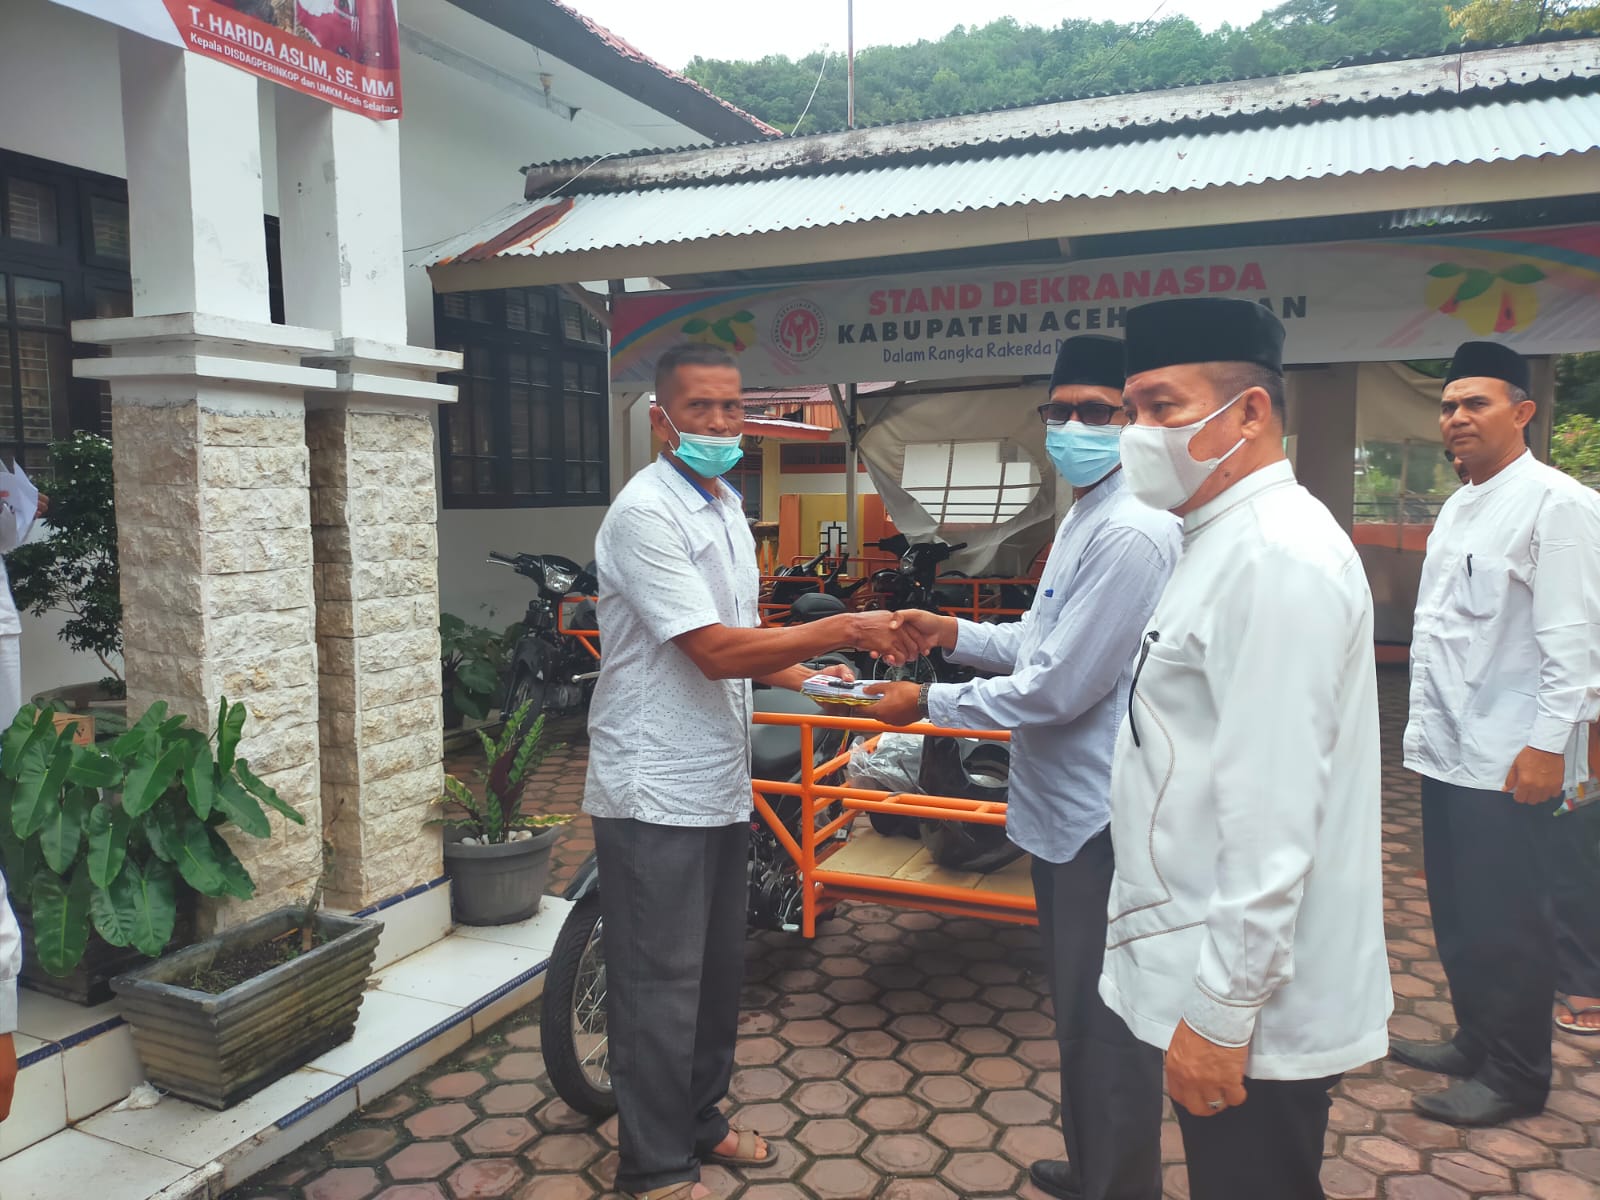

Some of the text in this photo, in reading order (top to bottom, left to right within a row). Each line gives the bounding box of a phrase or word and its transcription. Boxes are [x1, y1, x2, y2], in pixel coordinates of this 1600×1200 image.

[188, 5, 395, 97] T. HARIDA ASLIM, SE. MM
[190, 32, 223, 53] Kepala
[300, 76, 316, 89] dan
[316, 81, 342, 100] UMKM
[343, 93, 361, 106] Aceh
[868, 284, 982, 315] STAND
[993, 262, 1266, 308] DEKRANASDA
[838, 313, 1027, 344] KABUPATEN
[1039, 306, 1127, 332] ACEH
[883, 347, 925, 363] Dalam
[928, 344, 983, 363] Rangka
